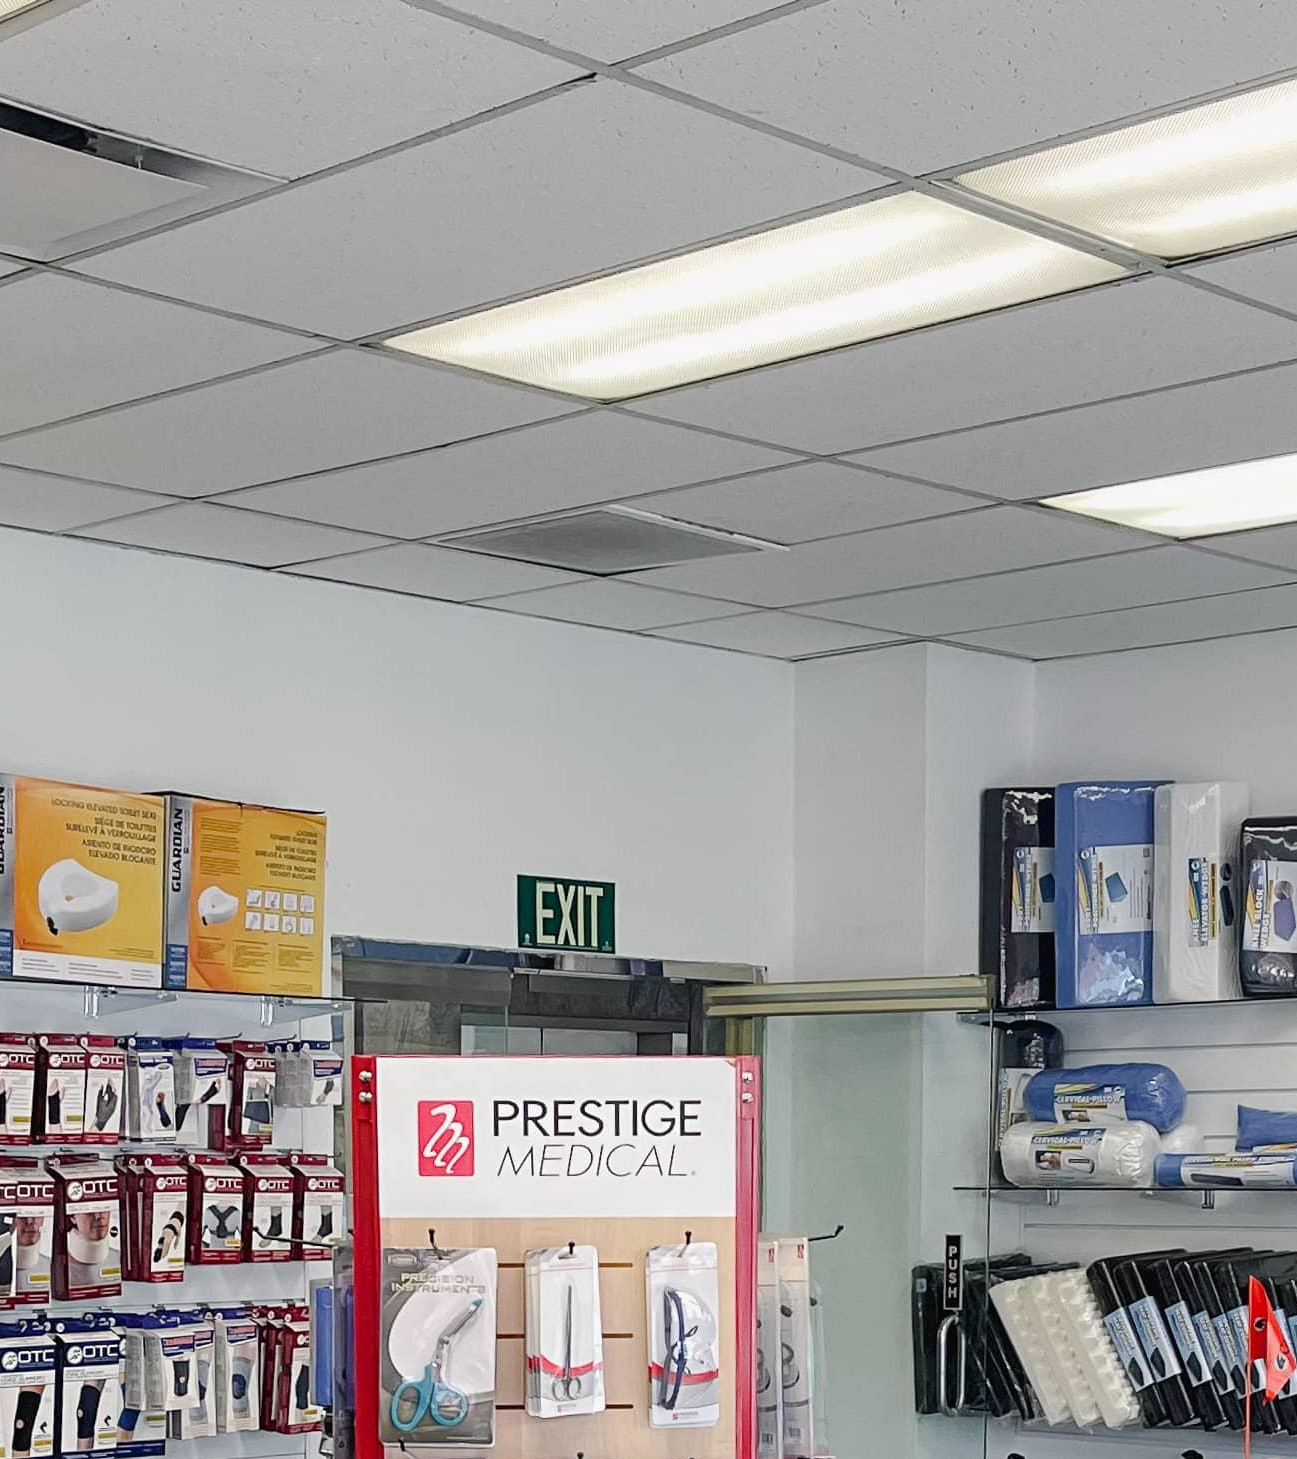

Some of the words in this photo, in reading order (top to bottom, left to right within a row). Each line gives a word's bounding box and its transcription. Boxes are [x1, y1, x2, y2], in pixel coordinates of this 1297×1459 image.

[171, 808, 184, 893] GUARDIAN
[1254, 888, 1264, 920] BLOCK
[536, 882, 604, 948] EXIT
[1260, 912, 1271, 948] WEDGE
[8, 1053, 34, 1066] OTC
[60, 1053, 85, 1066] OTC
[100, 1053, 125, 1066] OTC
[493, 1100, 703, 1138] PRESTIGE
[82, 1179, 118, 1194] OTC
[165, 1176, 187, 1188] OTC
[216, 1177, 243, 1188] OTC
[267, 1178, 290, 1190] OTC
[317, 1178, 340, 1189] OTC
[17, 1184, 55, 1198] OTC
[401, 1273, 474, 1283] PRECISION
[947, 1245, 958, 1299] PUSH
[17, 1350, 53, 1364] OTC
[82, 1344, 118, 1358] OTC
